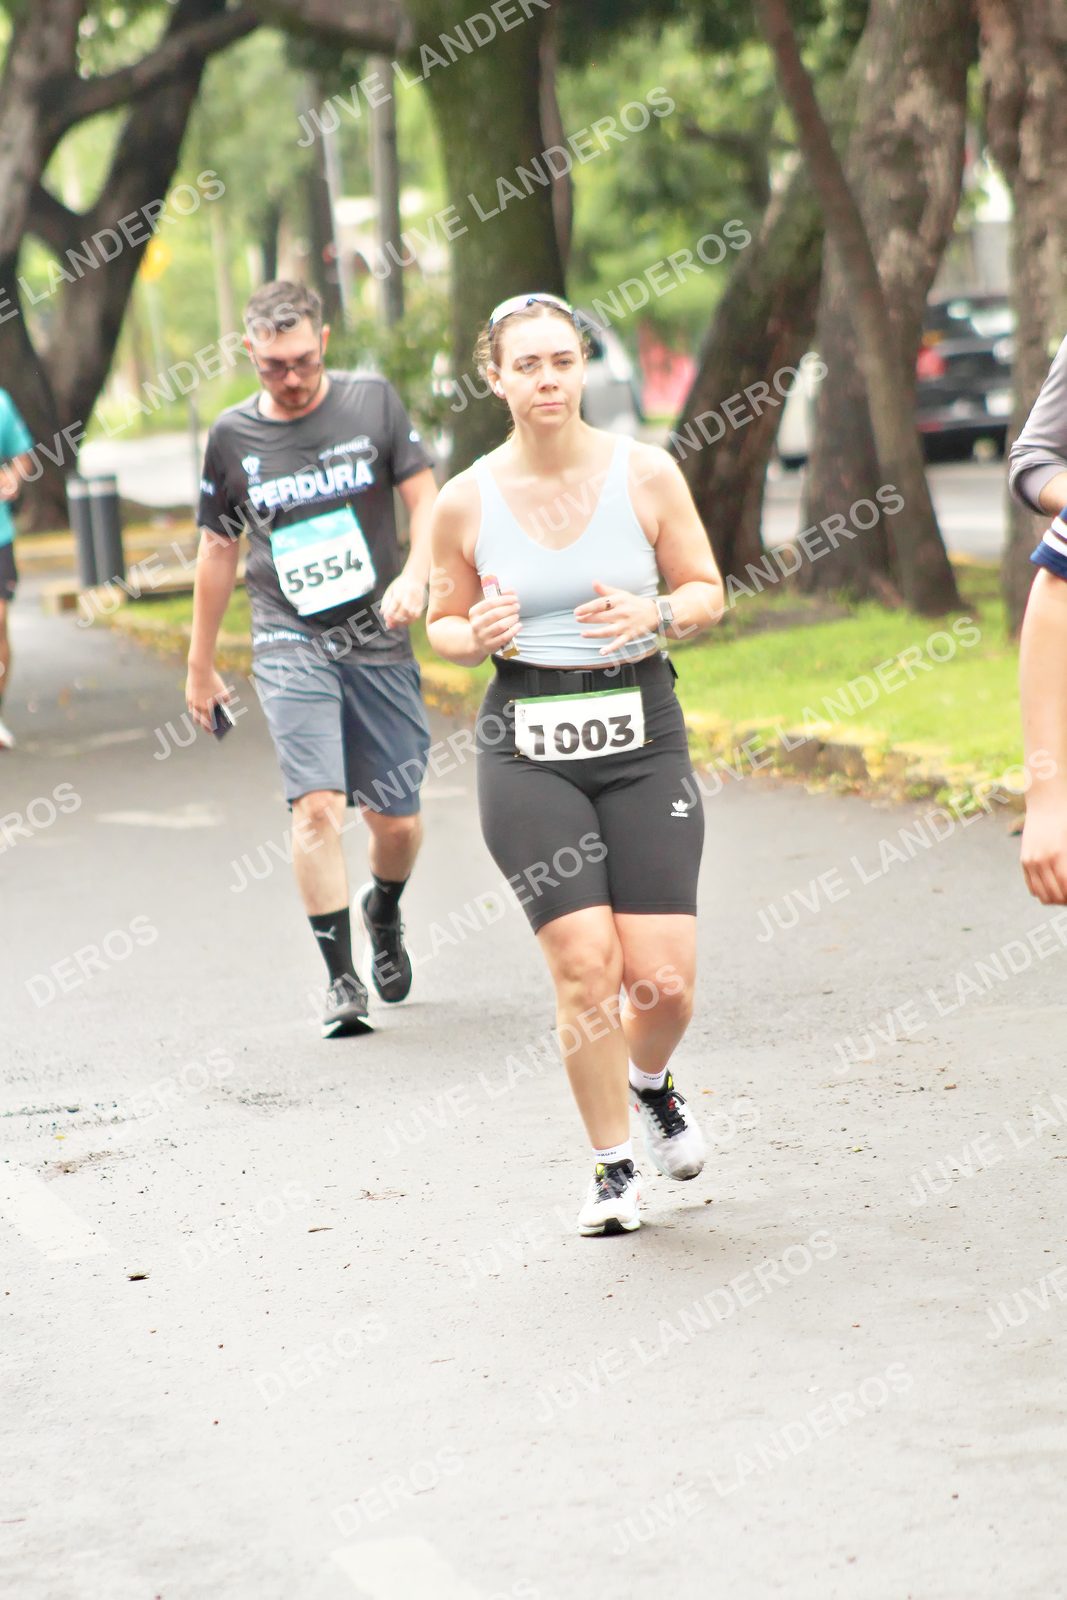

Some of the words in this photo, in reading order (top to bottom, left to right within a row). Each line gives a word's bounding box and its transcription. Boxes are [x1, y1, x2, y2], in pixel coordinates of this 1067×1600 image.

[248, 460, 374, 510] PERDURA
[285, 549, 363, 594] 5554
[528, 715, 635, 756] 1003
